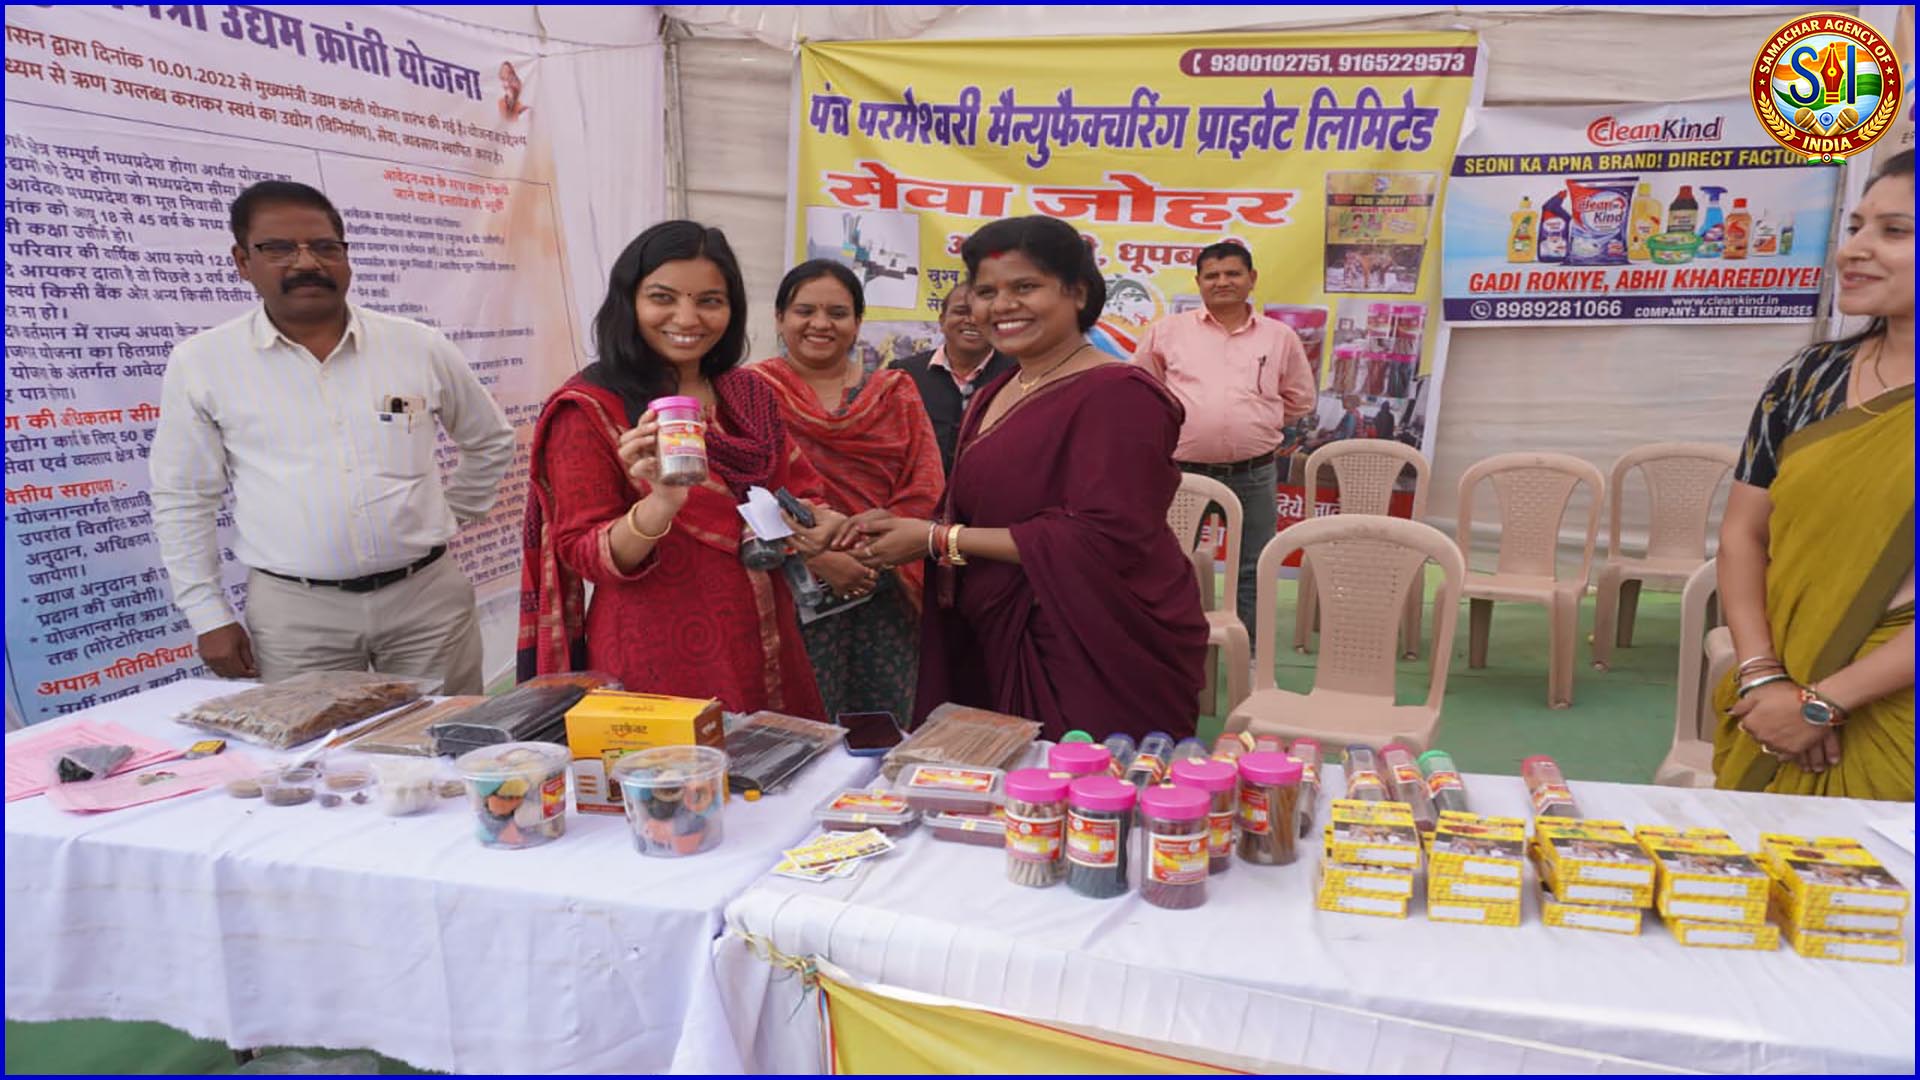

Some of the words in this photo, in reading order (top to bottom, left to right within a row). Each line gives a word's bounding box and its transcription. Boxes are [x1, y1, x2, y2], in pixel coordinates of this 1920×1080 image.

[6, 25, 45, 49] ासन
[50, 34, 87, 58] द्वारा
[91, 41, 144, 69] दिनांक
[148, 57, 236, 89] 10.01.2022
[238, 72, 252, 92] से
[256, 79, 309, 103] मुख्यमंत्री
[220, 5, 305, 56] उद्यम
[311, 21, 390, 77] क्रांती
[392, 40, 482, 100] योजना
[1210, 54, 1332, 73] 9300102751,
[1339, 53, 1465, 71] 9165229573
[5, 58, 44, 81] ध्यम
[49, 62, 66, 86] से
[71, 71, 107, 93] ऋण
[111, 79, 168, 104] उपलब्ध
[171, 90, 224, 113] कराकर
[225, 99, 256, 120] स्वयं
[259, 107, 278, 124] का
[280, 108, 313, 131] उद्योग
[809, 81, 852, 136] पंच
[857, 86, 982, 146] परमेश्वरी
[987, 86, 1190, 169] मैन्युफैक्चरिंग
[1197, 87, 1299, 160] प्राइवेट
[1304, 86, 1440, 152] लिमिटेड
[53, 145, 100, 165] सम्पूर्ण
[103, 151, 164, 172] मध्यप्रदेश
[168, 156, 197, 174] होगा
[1465, 157, 1514, 174] SEONI
[1520, 157, 1542, 173] KA
[1547, 156, 1593, 172] APNA
[1600, 153, 1663, 170] BRAND!
[1668, 151, 1735, 169] DIRECT
[88, 165, 121, 185] होगा
[124, 171, 143, 188] जो
[148, 176, 203, 195] मध्यप्रदेश
[207, 178, 236, 197] सीमा
[131, 190, 152, 207] का
[180, 194, 223, 214] निवासी
[826, 161, 1014, 218] सेवा
[1032, 172, 1293, 231] जोहर
[5, 197, 42, 215] नांक
[46, 198, 68, 217] को
[101, 210, 118, 224] 18
[121, 208, 135, 225] से
[138, 214, 156, 227] 45
[160, 212, 179, 229] वर्ष
[182, 213, 195, 228] के
[26, 222, 68, 239] कक्षा
[9, 239, 72, 259] परिवार
[77, 242, 99, 260] की
[208, 255, 235, 267] 12.0
[20, 265, 85, 279] आयकर
[195, 273, 202, 284] 3
[1469, 272, 1520, 292] GADI
[1526, 270, 1610, 294] ROKIYE,
[1615, 269, 1667, 290] ABHI
[1673, 267, 1821, 288] KHAREEDIYE!
[41, 282, 90, 300] किसी
[180, 287, 213, 303] किसी
[1672, 294, 1779, 306] www.cleankind.in
[19, 306, 36, 319] ना
[1495, 299, 1622, 318] 8989281066
[1634, 307, 1696, 318] COMPANY:
[1699, 306, 1735, 317] KATRE
[1737, 305, 1813, 317] ENTERPRISES
[72, 321, 88, 339] में
[92, 326, 130, 340] राज्य
[135, 324, 174, 339] अथवा
[38, 342, 81, 360] योजना
[87, 346, 112, 359] का
[122, 361, 166, 378] आवेद
[18, 387, 47, 402] पात्र
[26, 408, 56, 431] की
[120, 430, 137, 442] 50
[40, 453, 67, 473] एवं
[18, 525, 71, 547] उपरांत
[25, 545, 88, 568] अनुदान,
[28, 563, 87, 587] जायेगा।
[80, 574, 137, 598] अनुदान
[36, 609, 79, 628] प्रदान
[83, 598, 106, 617] की
[45, 611, 136, 646] योजनान्तर्गत
[46, 648, 79, 667] तक
[37, 669, 101, 697] अपात्र
